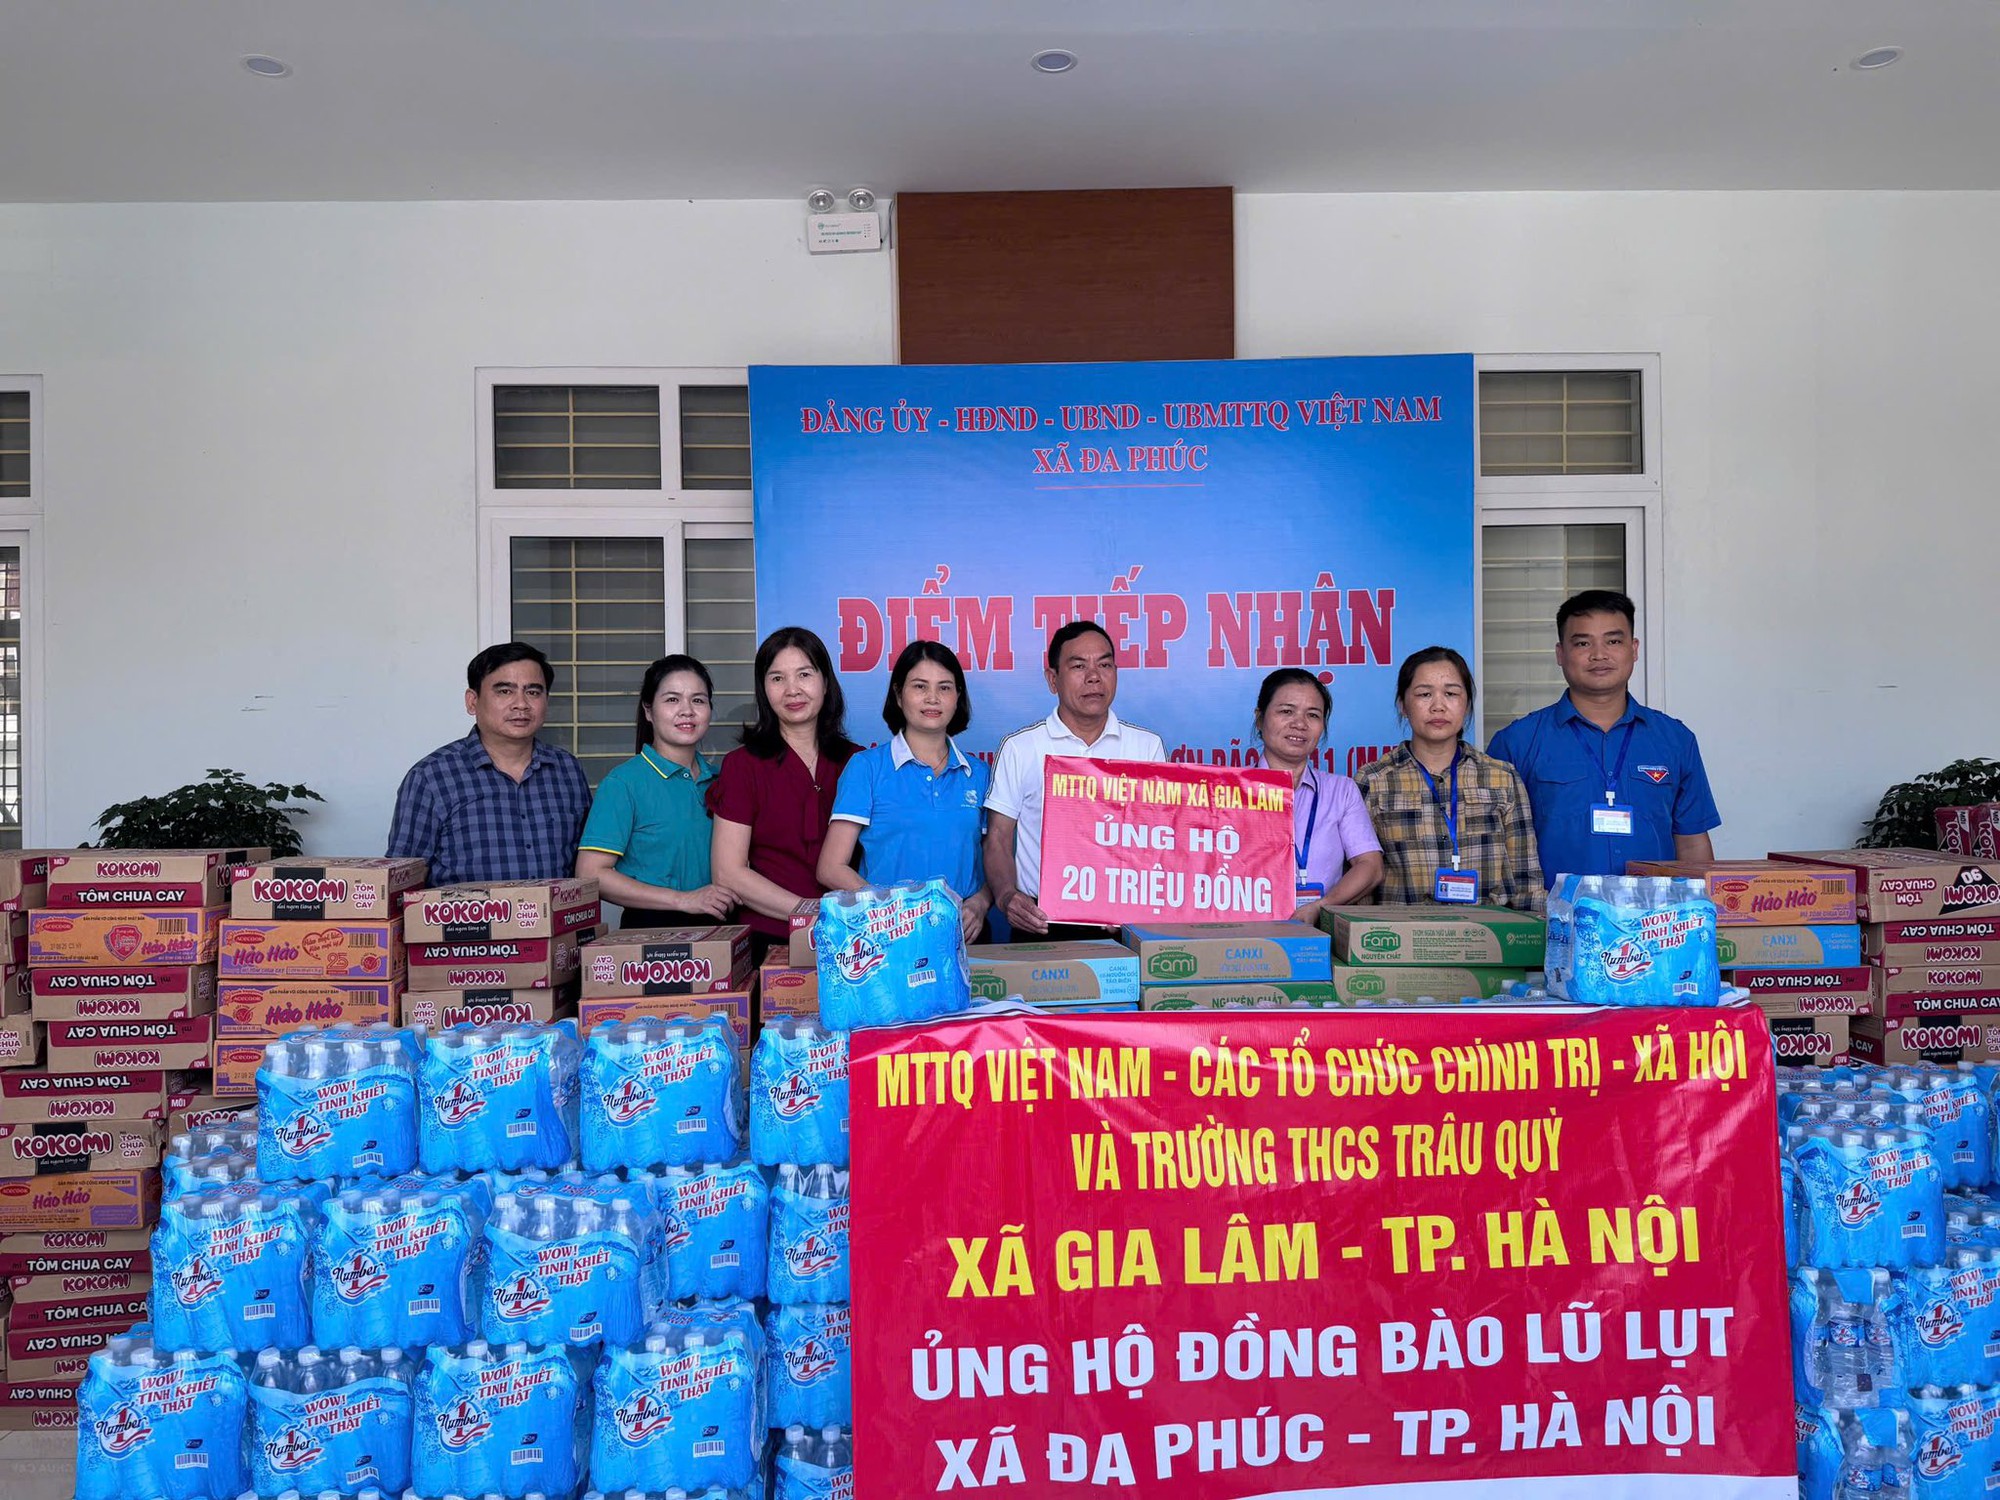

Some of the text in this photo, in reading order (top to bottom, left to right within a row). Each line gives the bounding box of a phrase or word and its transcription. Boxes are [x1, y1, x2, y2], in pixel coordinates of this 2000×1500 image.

[801, 399, 885, 432] ĐẢNG
[890, 398, 932, 432] ỦY
[954, 406, 1038, 432] HĐND
[1061, 404, 1141, 431] UBND
[1163, 400, 1289, 431] UBMTTQ
[1296, 391, 1366, 431] VIỆT
[1372, 396, 1442, 423] NAM
[1033, 438, 1208, 474] XÃ ĐA PHÚC
[837, 564, 1014, 673] ĐIỂM
[1206, 571, 1395, 686] NHẬN
[1053, 772, 1284, 812] MTTQ VIỆT NAM XÃ GIA LÂM
[1095, 814, 1240, 860] ỦNG HỘ
[96, 861, 161, 877] KOKOMI
[253, 879, 347, 902] KOKOMI
[355, 884, 374, 893] TÔM
[1061, 863, 1272, 915] 20 TRIỆU ĐỒNG
[1881, 880, 1936, 891] CHUA CAY
[78, 888, 185, 903] TÔM CHUA CAY
[353, 893, 376, 901] CHUA
[1751, 887, 1817, 912] Hảo Hảo
[1896, 893, 1922, 906] TÔM
[1943, 884, 2000, 905] OKOMI
[355, 901, 373, 909] CAY
[424, 900, 511, 925] KOKOMI
[518, 903, 536, 911] TÔM
[868, 900, 902, 919] WOW!
[516, 911, 538, 919] CHUA
[1641, 911, 1678, 929] WOW!
[519, 920, 536, 928] CAY
[868, 919, 895, 933] TINH
[888, 922, 915, 941] THẬT
[1901, 923, 1994, 937] TÔM CHUA CAY
[1641, 929, 1667, 941] TINH
[1659, 934, 1687, 949] THẬT
[232, 946, 265, 966] Hảo
[267, 942, 299, 961] Hảo
[425, 944, 519, 958] TÔM CHUA CAY
[836, 943, 879, 966] Number
[1225, 948, 1263, 960] CANXI
[1387, 952, 1402, 960] CHẤT
[1601, 951, 1645, 966] Number
[1926, 946, 1982, 961] KOKOMI
[621, 960, 712, 984] KOKOMI
[1031, 968, 1070, 981] CANXI
[1928, 970, 1982, 984] KOKOMI
[49, 974, 155, 988] TÔM CHUA CAY
[1750, 975, 1841, 988] TÔM CHUA CAY
[78, 1000, 142, 1016] KOKOMI
[266, 997, 343, 1025] Hảo Hảo
[1799, 997, 1856, 1013] KOKOMI
[1902, 1026, 1981, 1050] KOKOMI
[877, 1049, 974, 1110] MTTQ
[985, 1037, 1056, 1113] VIỆT
[1067, 1047, 1151, 1099] NAM
[1188, 1036, 1261, 1098] CÁC
[1270, 1027, 1316, 1098] TỔ
[1327, 1037, 1421, 1097] CHỨC
[1433, 1037, 1538, 1094] CHÍNH
[1547, 1036, 1600, 1097] TRỊ
[1631, 1024, 1677, 1083] XÃ
[1688, 1019, 1747, 1091] HỘI
[13, 1133, 112, 1159] KOKOMI
[1070, 1107, 1563, 1191] VÀ TRƯỜNG THCS TRÂU QUỲ
[33, 1187, 91, 1210] Hảo Hảo
[538, 1245, 579, 1262] WOW!
[946, 1223, 1035, 1298] XÃ
[1055, 1228, 1161, 1292] GIA
[1183, 1213, 1320, 1284] LÂM
[1382, 1215, 1465, 1274] TP.
[1485, 1197, 1571, 1268] HÀ
[1588, 1194, 1700, 1276] NỘI
[27, 1258, 132, 1271] TÔM CHUA CAY
[537, 1261, 570, 1277] TINH
[62, 1274, 130, 1293] KOKOMI
[558, 1269, 591, 1286] THẬT
[493, 1285, 545, 1304] Number
[911, 1301, 1734, 1401] ỦNG HỘ ĐỒNG BÀO LŨ LỤT
[660, 1355, 700, 1378] WOW!
[659, 1376, 689, 1393] TINH
[678, 1381, 713, 1401] THẬT
[615, 1403, 667, 1425] Number
[935, 1424, 1026, 1492] XÃ
[1046, 1432, 1137, 1486] ĐA
[1154, 1405, 1324, 1480] PHÚC
[1393, 1408, 1476, 1457] TP.
[1500, 1391, 1582, 1451] HÀ
[1604, 1384, 1715, 1457] NỘI
